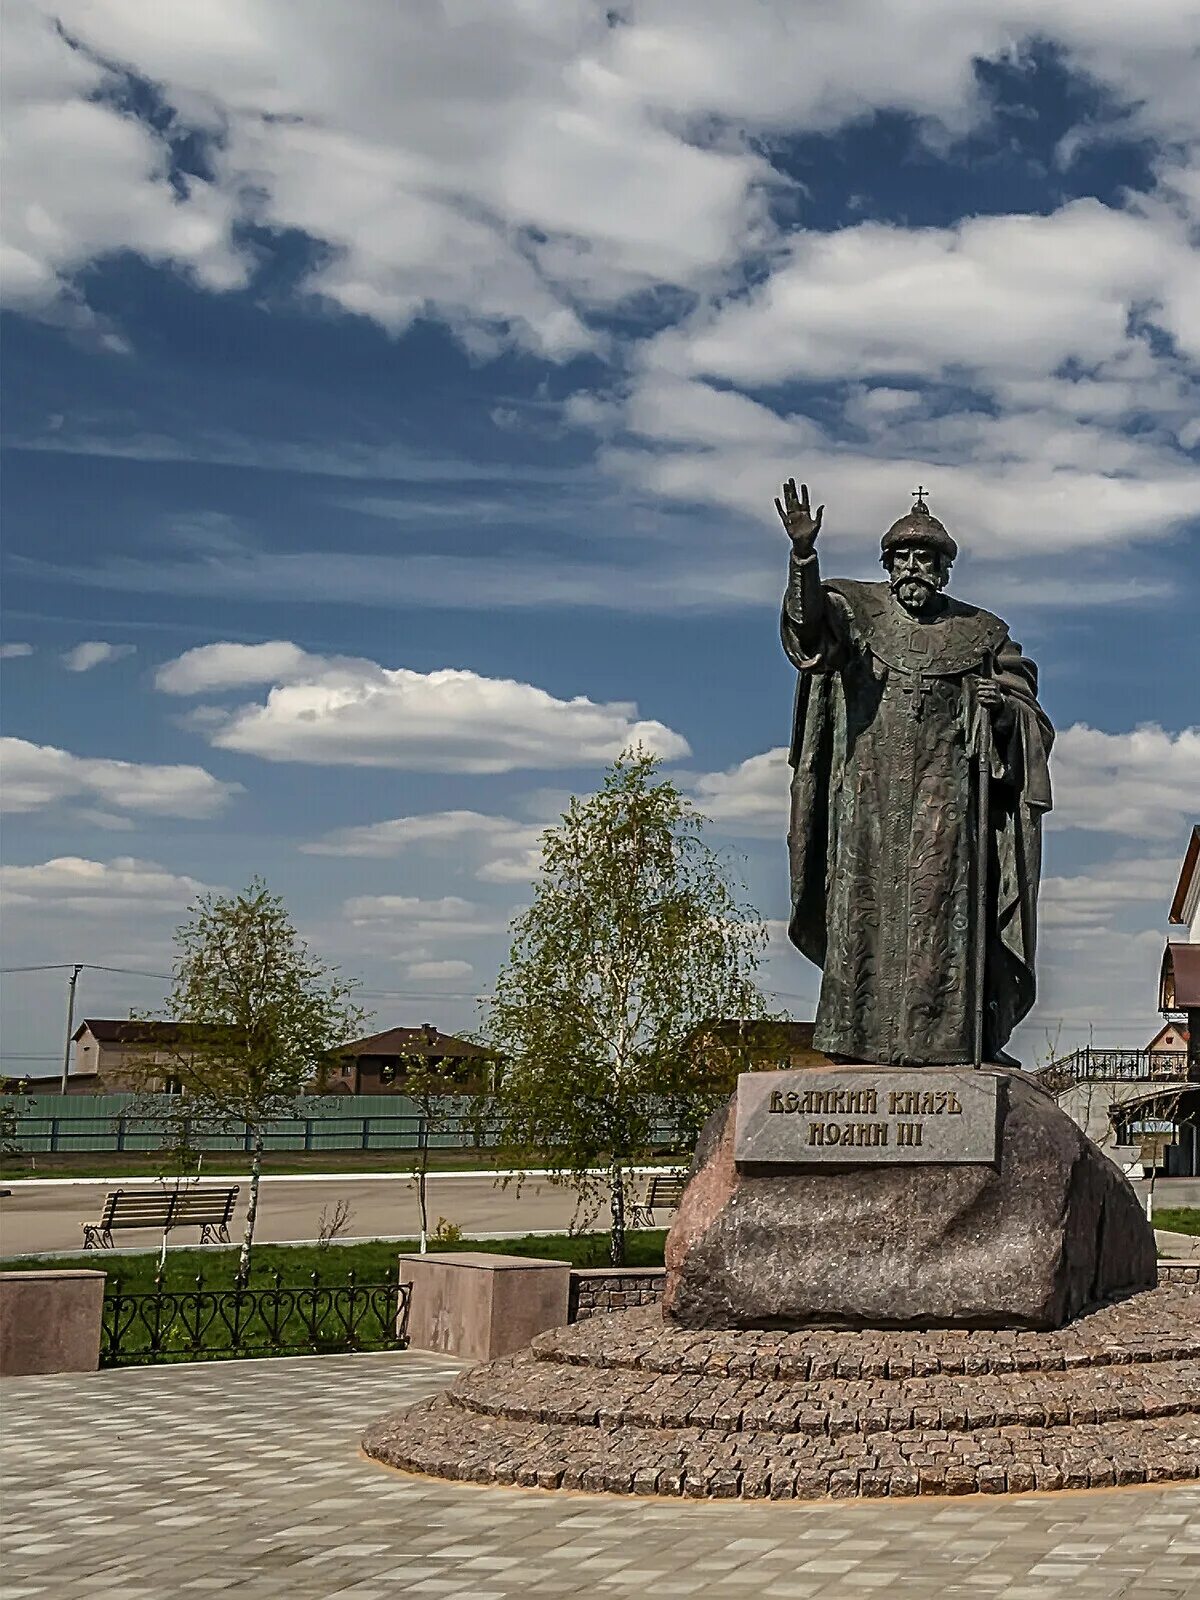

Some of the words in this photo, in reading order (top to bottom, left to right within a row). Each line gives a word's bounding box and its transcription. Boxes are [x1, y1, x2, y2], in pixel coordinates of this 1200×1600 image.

[769, 1089, 877, 1114] ВЕЛИКИЙ
[808, 1122, 888, 1146] ИОАНН
[896, 1122, 923, 1146] III
